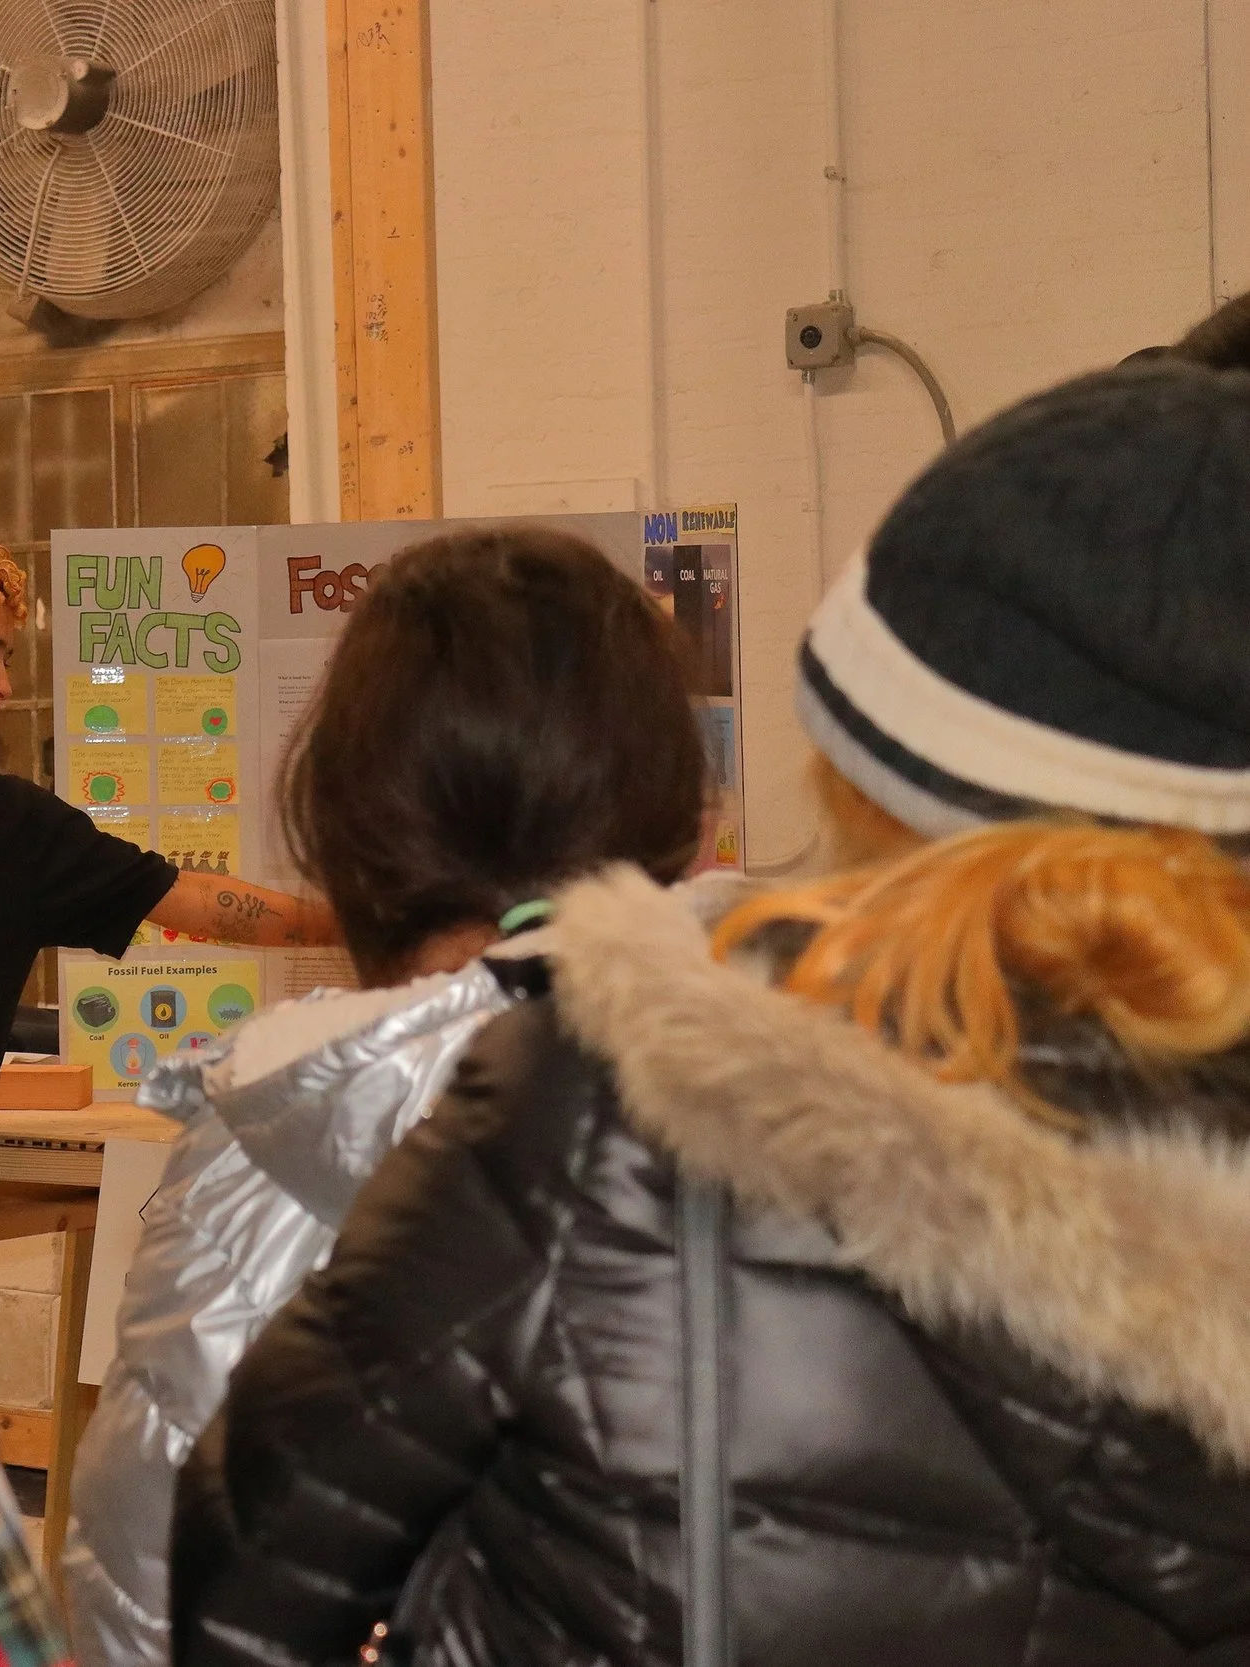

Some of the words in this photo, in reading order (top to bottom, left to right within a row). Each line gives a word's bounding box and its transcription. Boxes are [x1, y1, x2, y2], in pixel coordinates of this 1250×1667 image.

[644, 512, 678, 545] NON
[682, 510, 735, 532] RENEWABLE
[653, 570, 664, 582] OIL
[679, 569, 696, 581] COAL
[703, 569, 728, 580] NATURAL
[66, 554, 162, 610] FUN
[710, 582, 722, 594] GAS
[79, 611, 241, 674] FACTS
[108, 966, 138, 976] Fossil
[141, 966, 163, 976] Fuel
[166, 965, 218, 977] Examples
